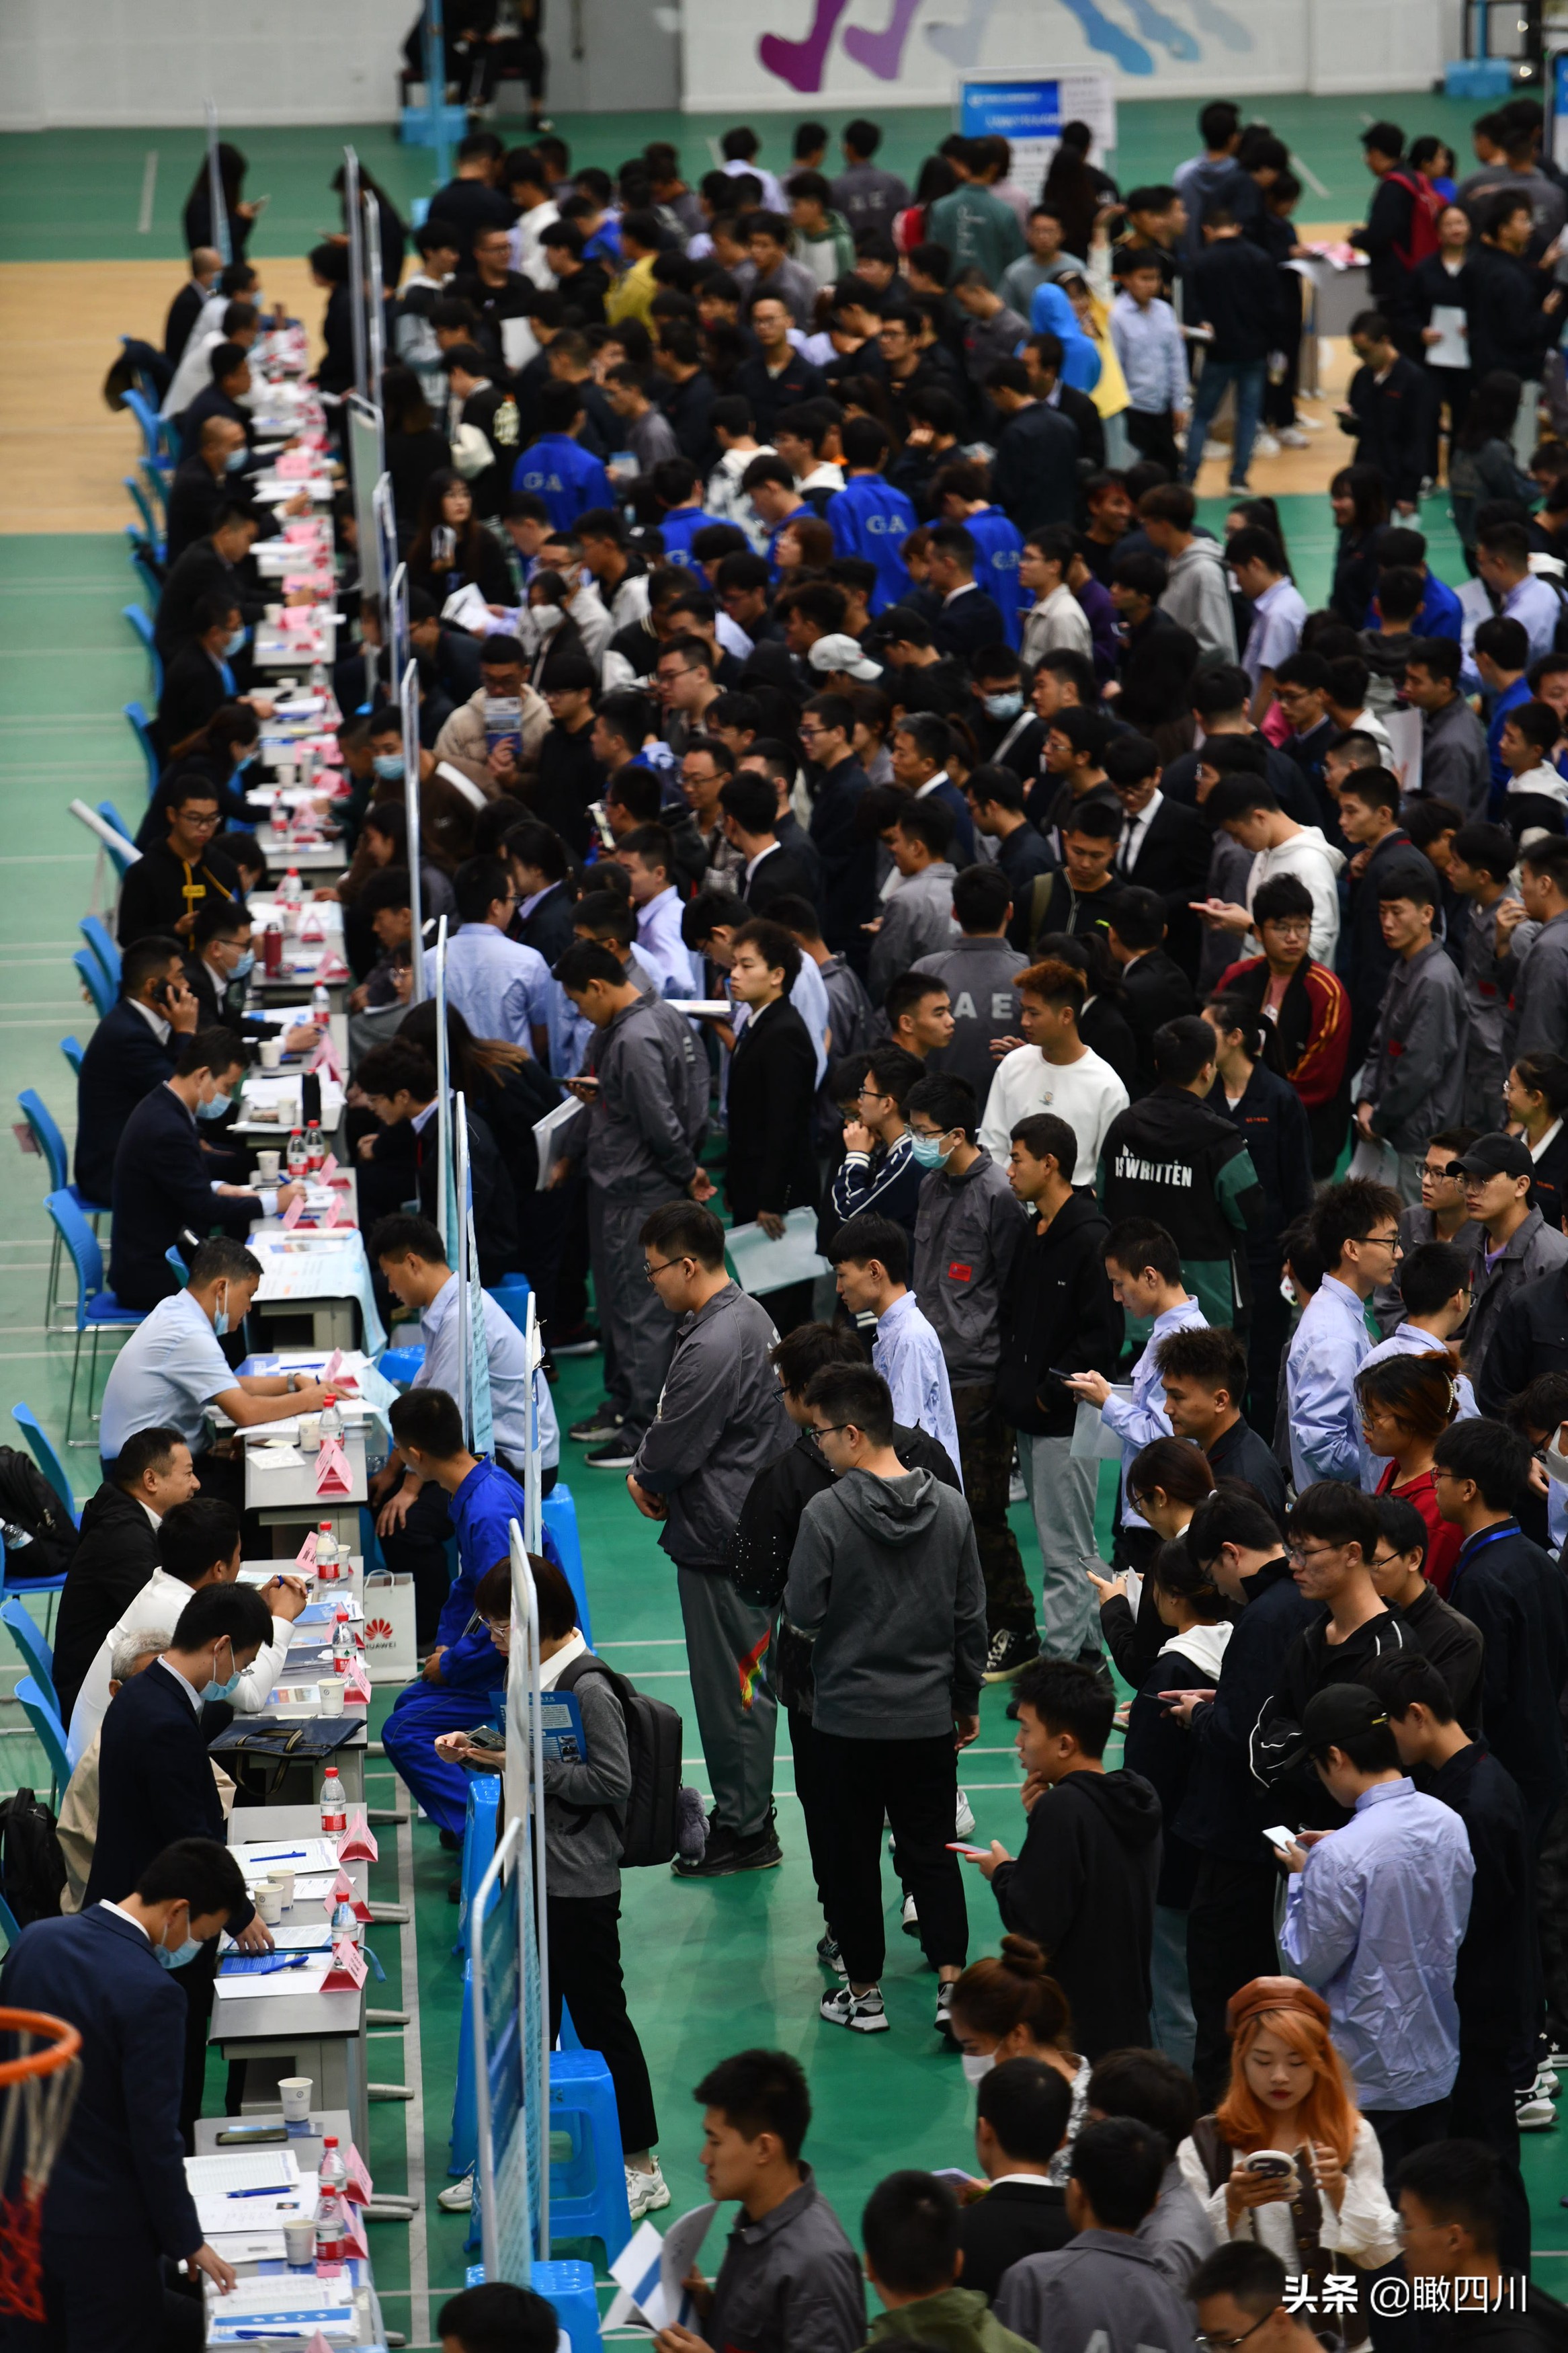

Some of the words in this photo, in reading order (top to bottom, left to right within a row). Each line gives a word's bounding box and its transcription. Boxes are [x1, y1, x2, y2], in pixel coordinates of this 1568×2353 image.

[524, 472, 563, 492] GA
[866, 515, 907, 534] GA
[1115, 1156, 1124, 1177] IS
[1126, 1157, 1192, 1187] WRITTEN
